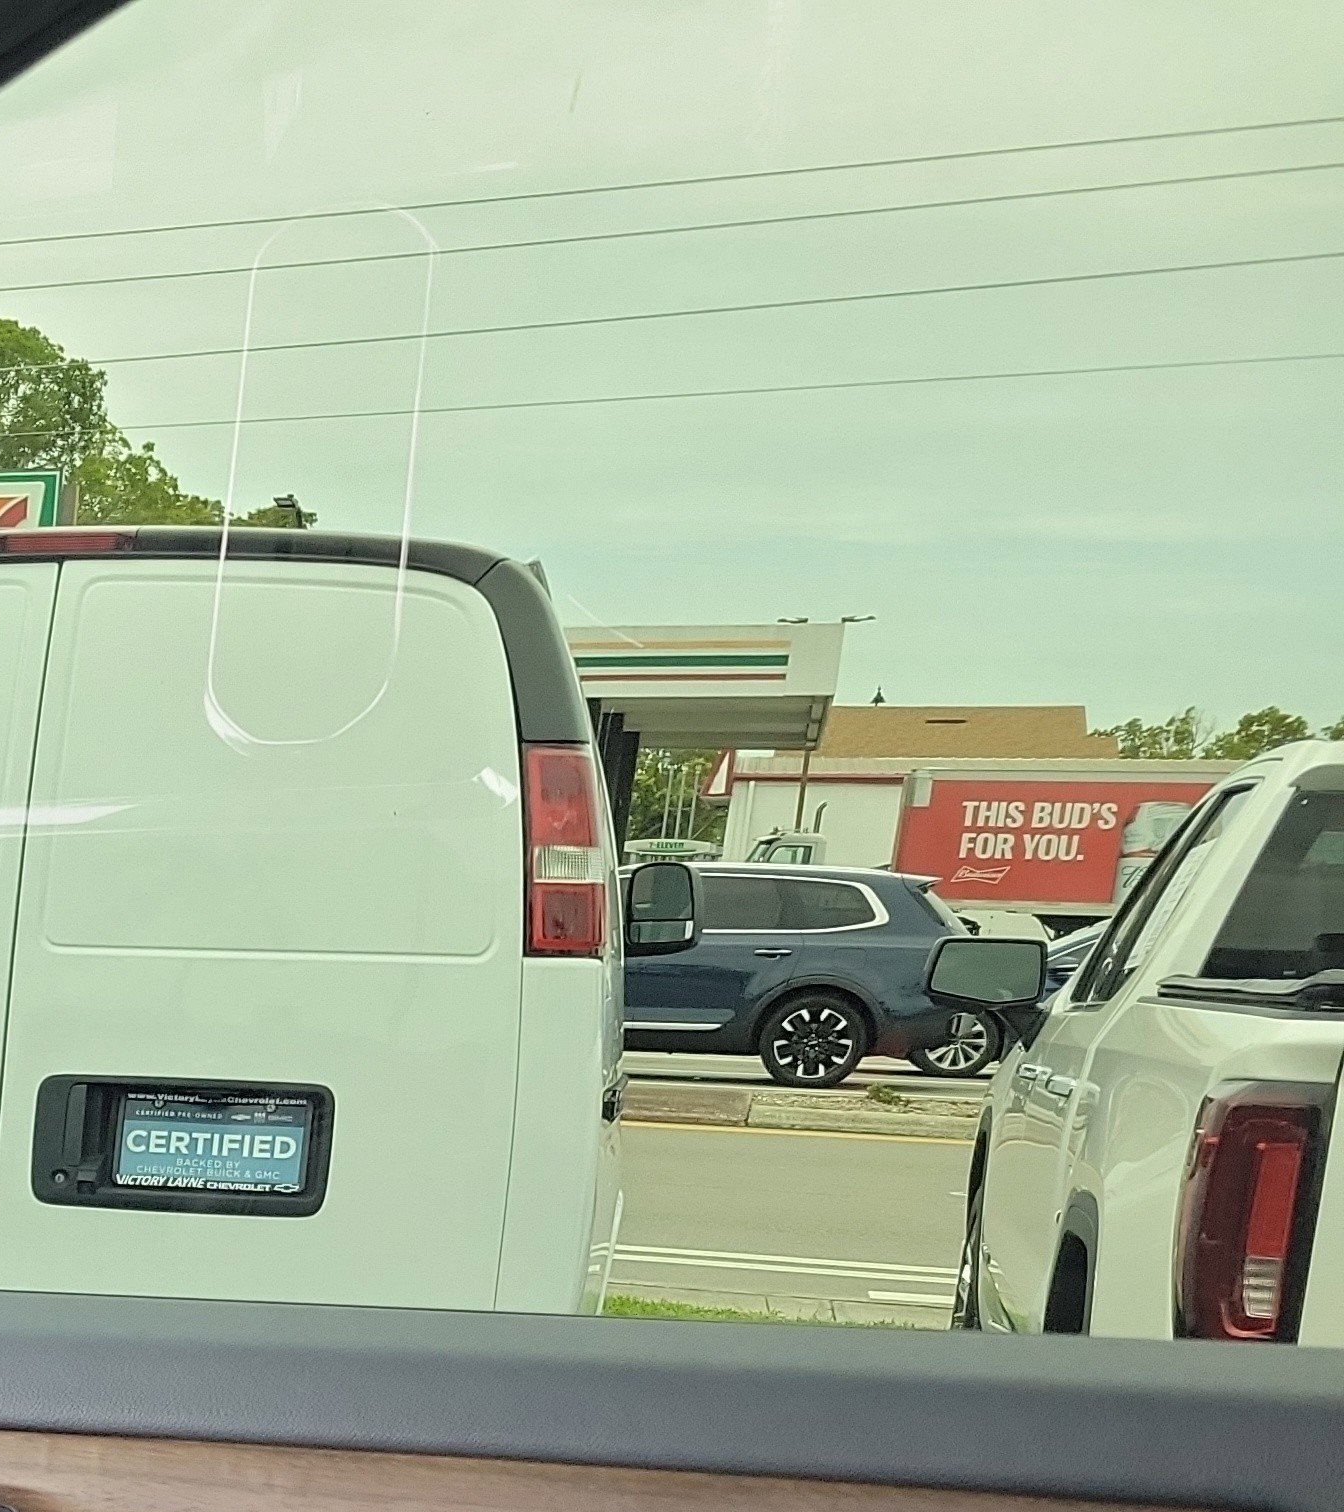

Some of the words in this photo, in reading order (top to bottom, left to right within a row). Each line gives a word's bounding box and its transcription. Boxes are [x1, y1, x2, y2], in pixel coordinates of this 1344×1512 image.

[962, 801, 1025, 827] THIS
[1031, 802, 1118, 830] BUD'S
[958, 832, 1015, 860] FOR
[1022, 833, 1084, 861] YOU.
[127, 1092, 308, 1105] www.VictoryLChevrolet.com
[135, 1109, 175, 1117] CERTIFIED
[126, 1129, 297, 1160] CERTIFIED
[176, 1158, 221, 1169] BACKED
[226, 1160, 241, 1169] BY
[136, 1165, 202, 1176] CHEVROLET
[207, 1168, 241, 1178] BUICK
[245, 1170, 251, 1179] &
[255, 1171, 280, 1180] GMC
[115, 1173, 165, 1187] VICTORY
[167, 1176, 206, 1188] LAYNE
[206, 1182, 272, 1192] CHEVROLET
